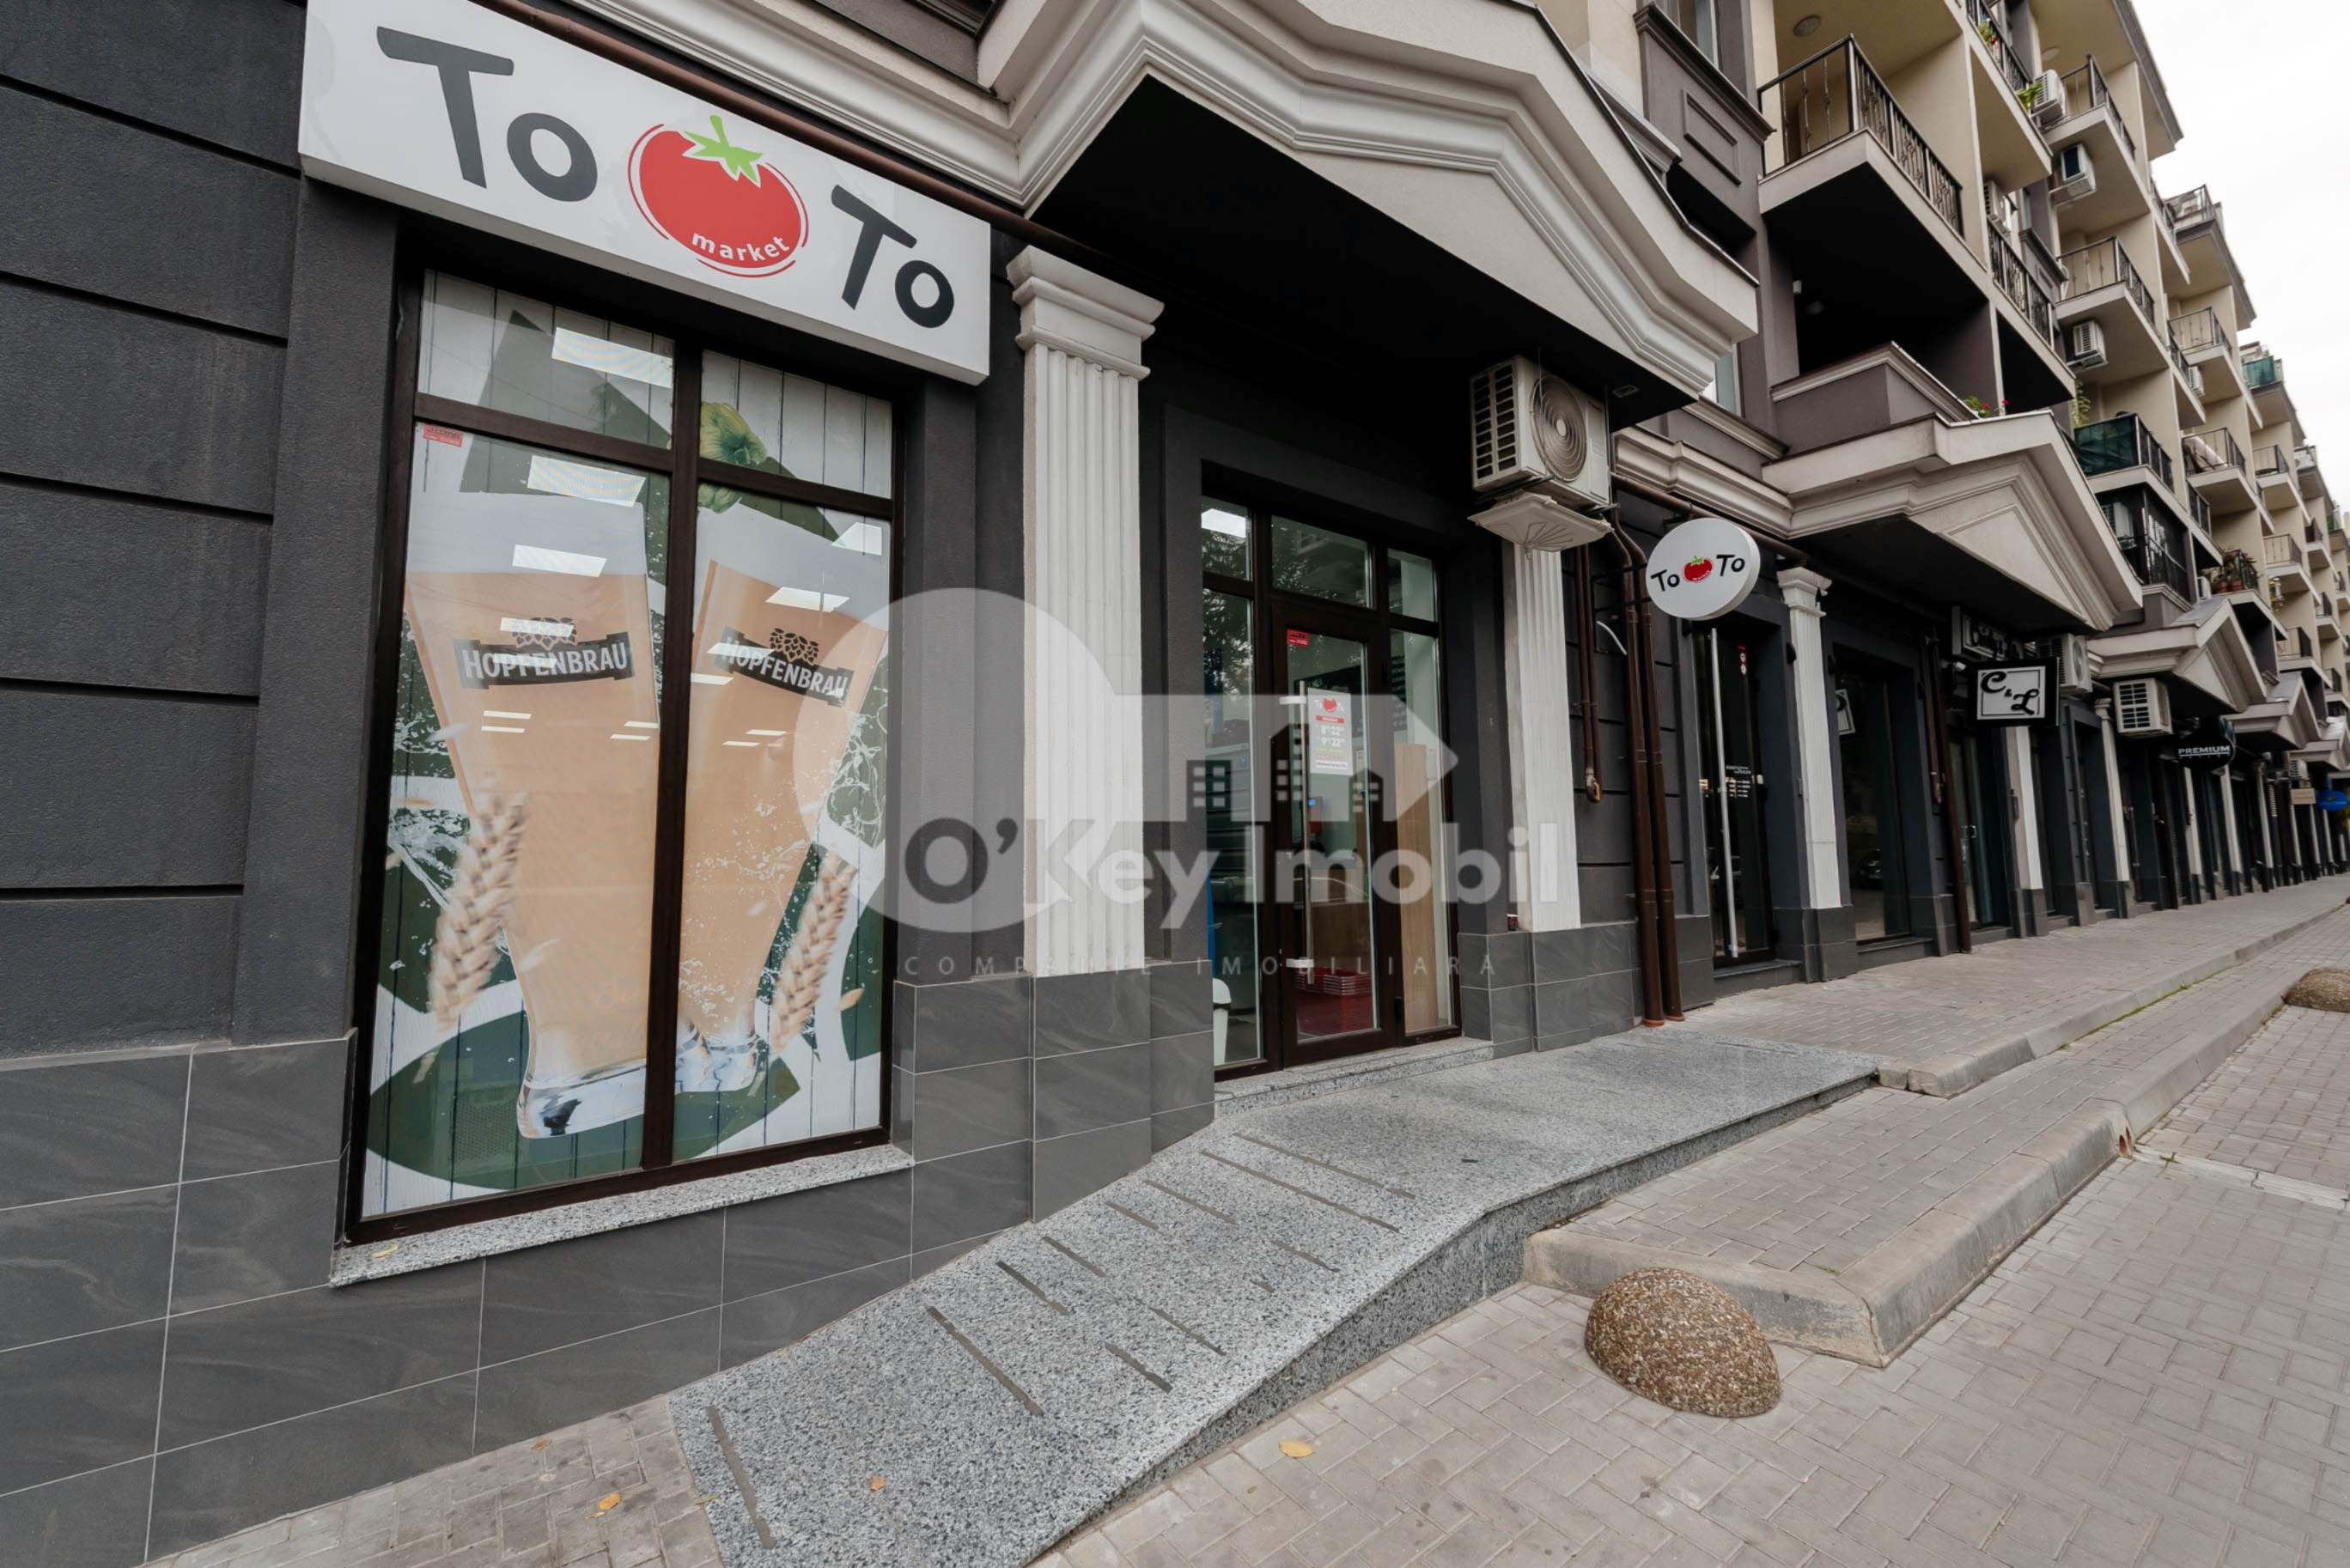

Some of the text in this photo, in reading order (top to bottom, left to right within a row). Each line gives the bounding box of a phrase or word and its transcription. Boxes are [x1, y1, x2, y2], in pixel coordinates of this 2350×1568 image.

[375, 26, 955, 329] To To
[691, 233, 790, 262] market
[1650, 554, 1745, 592] To To
[2177, 745, 2231, 755] PREMIUM
